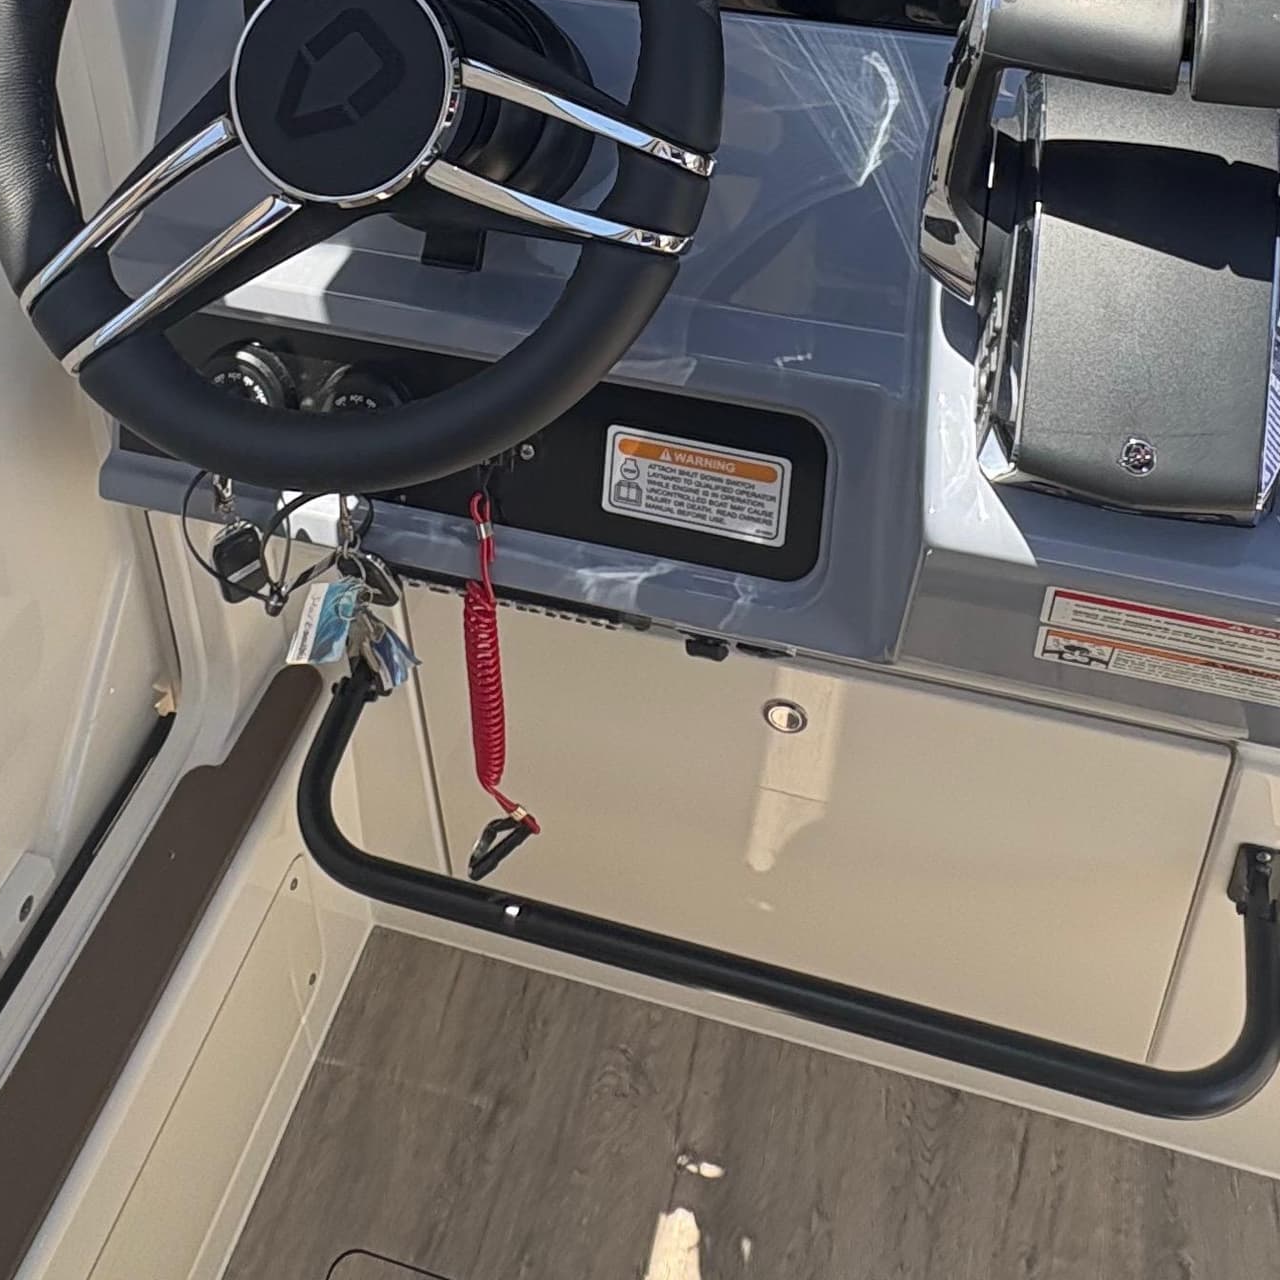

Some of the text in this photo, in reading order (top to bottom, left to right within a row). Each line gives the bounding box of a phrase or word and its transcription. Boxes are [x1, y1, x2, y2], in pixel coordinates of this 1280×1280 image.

[673, 451, 737, 474] WARNING
[646, 487, 707, 504] UNCONTROLLED
[735, 487, 777, 502] OPERATOR
